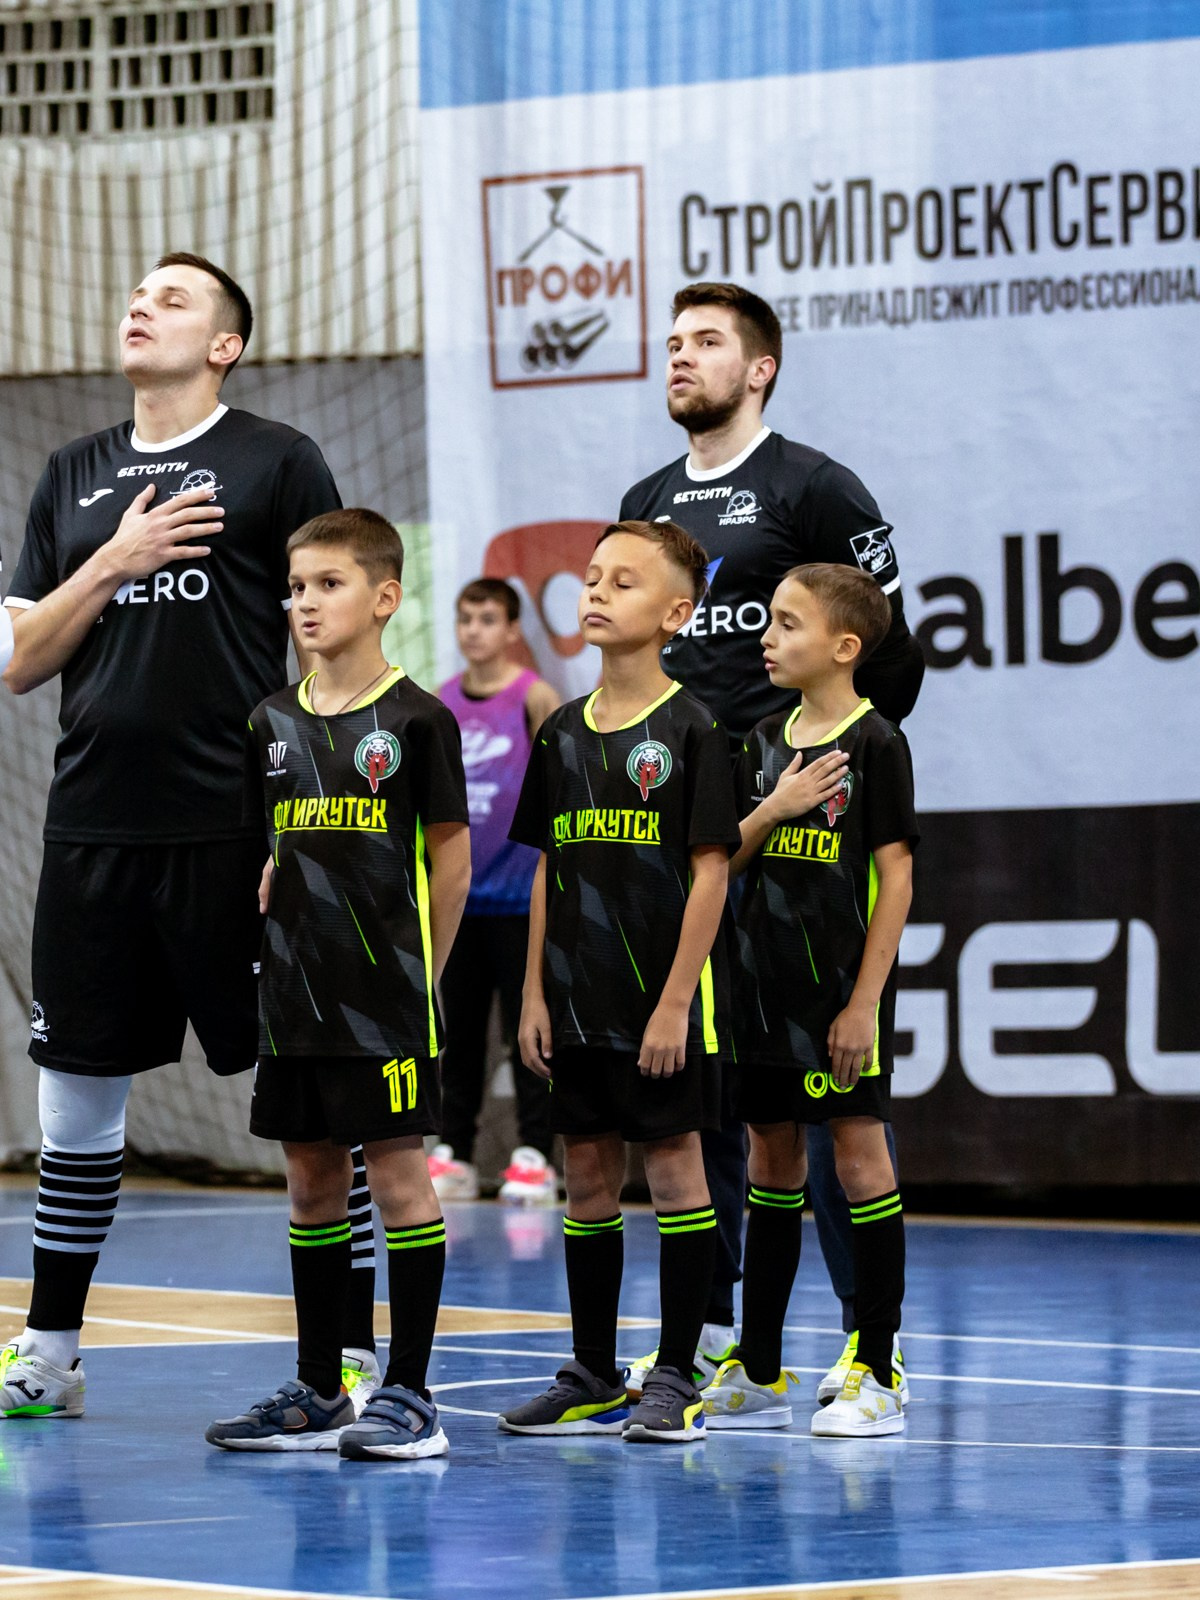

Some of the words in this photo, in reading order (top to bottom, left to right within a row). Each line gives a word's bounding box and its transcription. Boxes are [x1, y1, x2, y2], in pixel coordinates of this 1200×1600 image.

[496, 258, 633, 308] ПРОФИ
[809, 280, 1002, 331] ПРИНАДЛЕЖИТ
[117, 461, 189, 478] БЕТСИТИ
[673, 486, 733, 504] БЕТСИТИ
[718, 515, 757, 526] ИРАЭРО
[274, 800, 292, 830] ФК
[293, 797, 388, 828] ИРКУТСК
[576, 809, 661, 841] ИРКУТСК
[382, 1057, 417, 1113] 11
